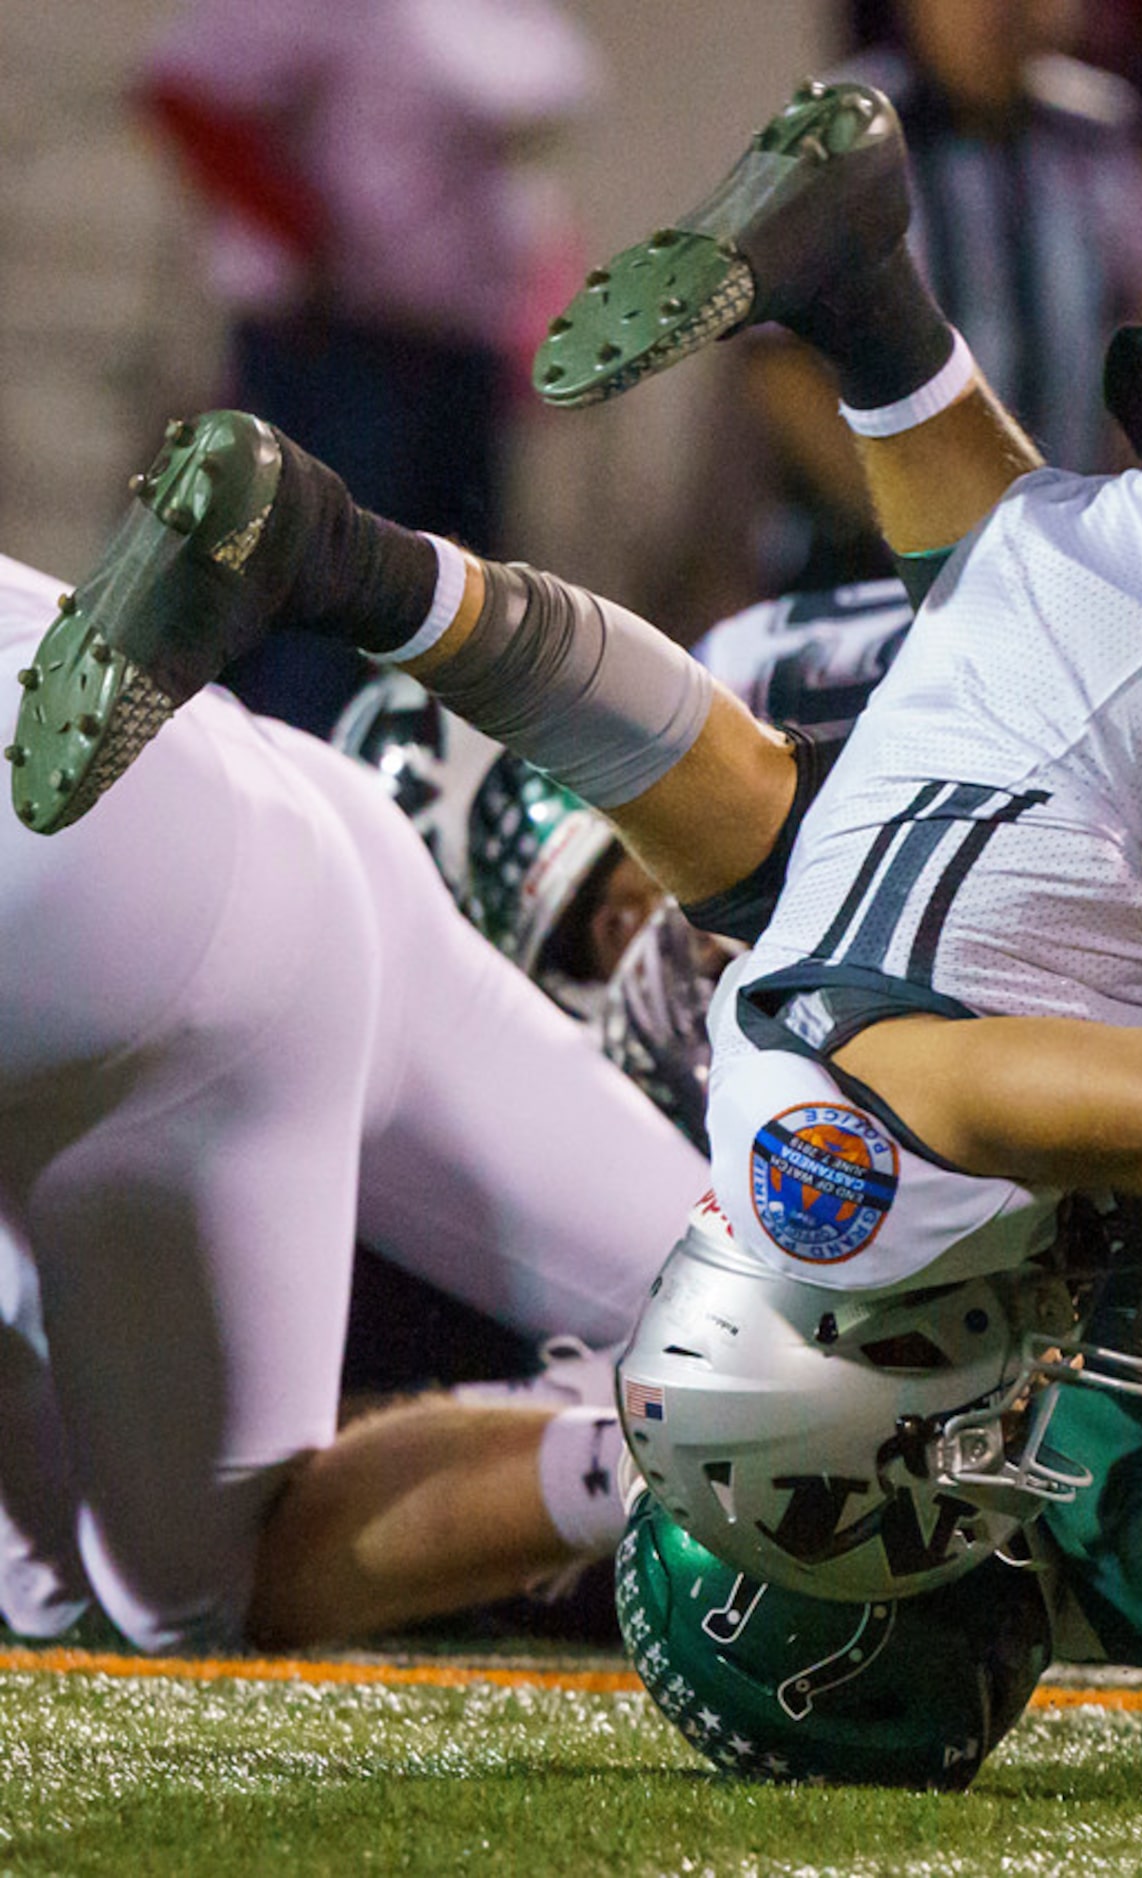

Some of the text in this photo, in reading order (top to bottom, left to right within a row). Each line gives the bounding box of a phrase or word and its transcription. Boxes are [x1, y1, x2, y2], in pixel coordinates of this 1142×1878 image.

[803, 1107, 889, 1154] POLICE
[769, 1154, 865, 1204] END OF WATCH
[781, 1144, 866, 1191] CASTANEDA
[832, 1154, 867, 1177] JUNE
[810, 1208, 879, 1258] GRAND
